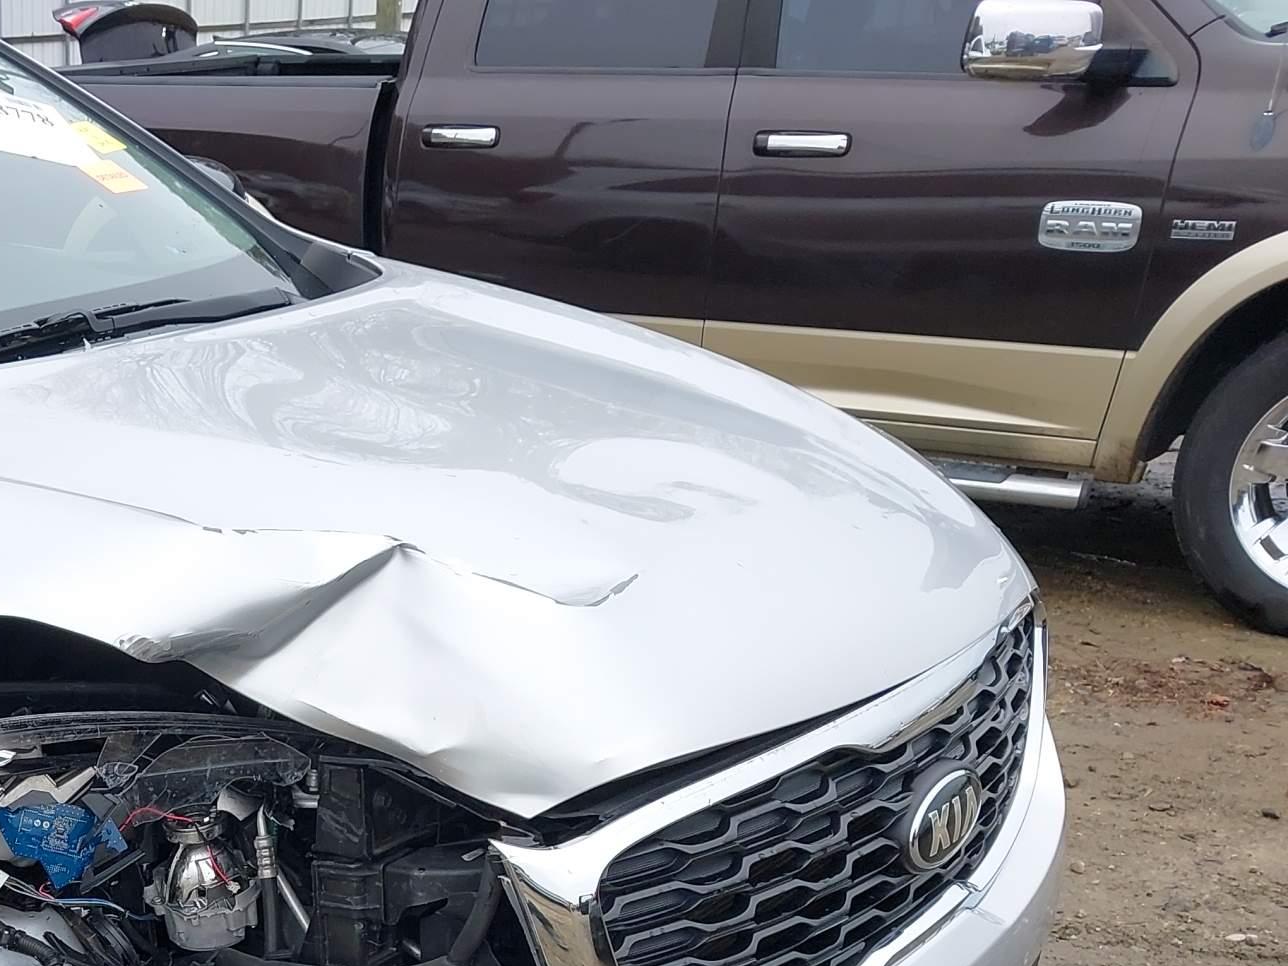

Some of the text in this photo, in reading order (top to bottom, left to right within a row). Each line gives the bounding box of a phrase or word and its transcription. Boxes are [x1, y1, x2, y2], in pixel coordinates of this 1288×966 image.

[1046, 219, 1133, 237] RAM
[1172, 220, 1234, 231] HEMI
[928, 786, 978, 857] KIA
